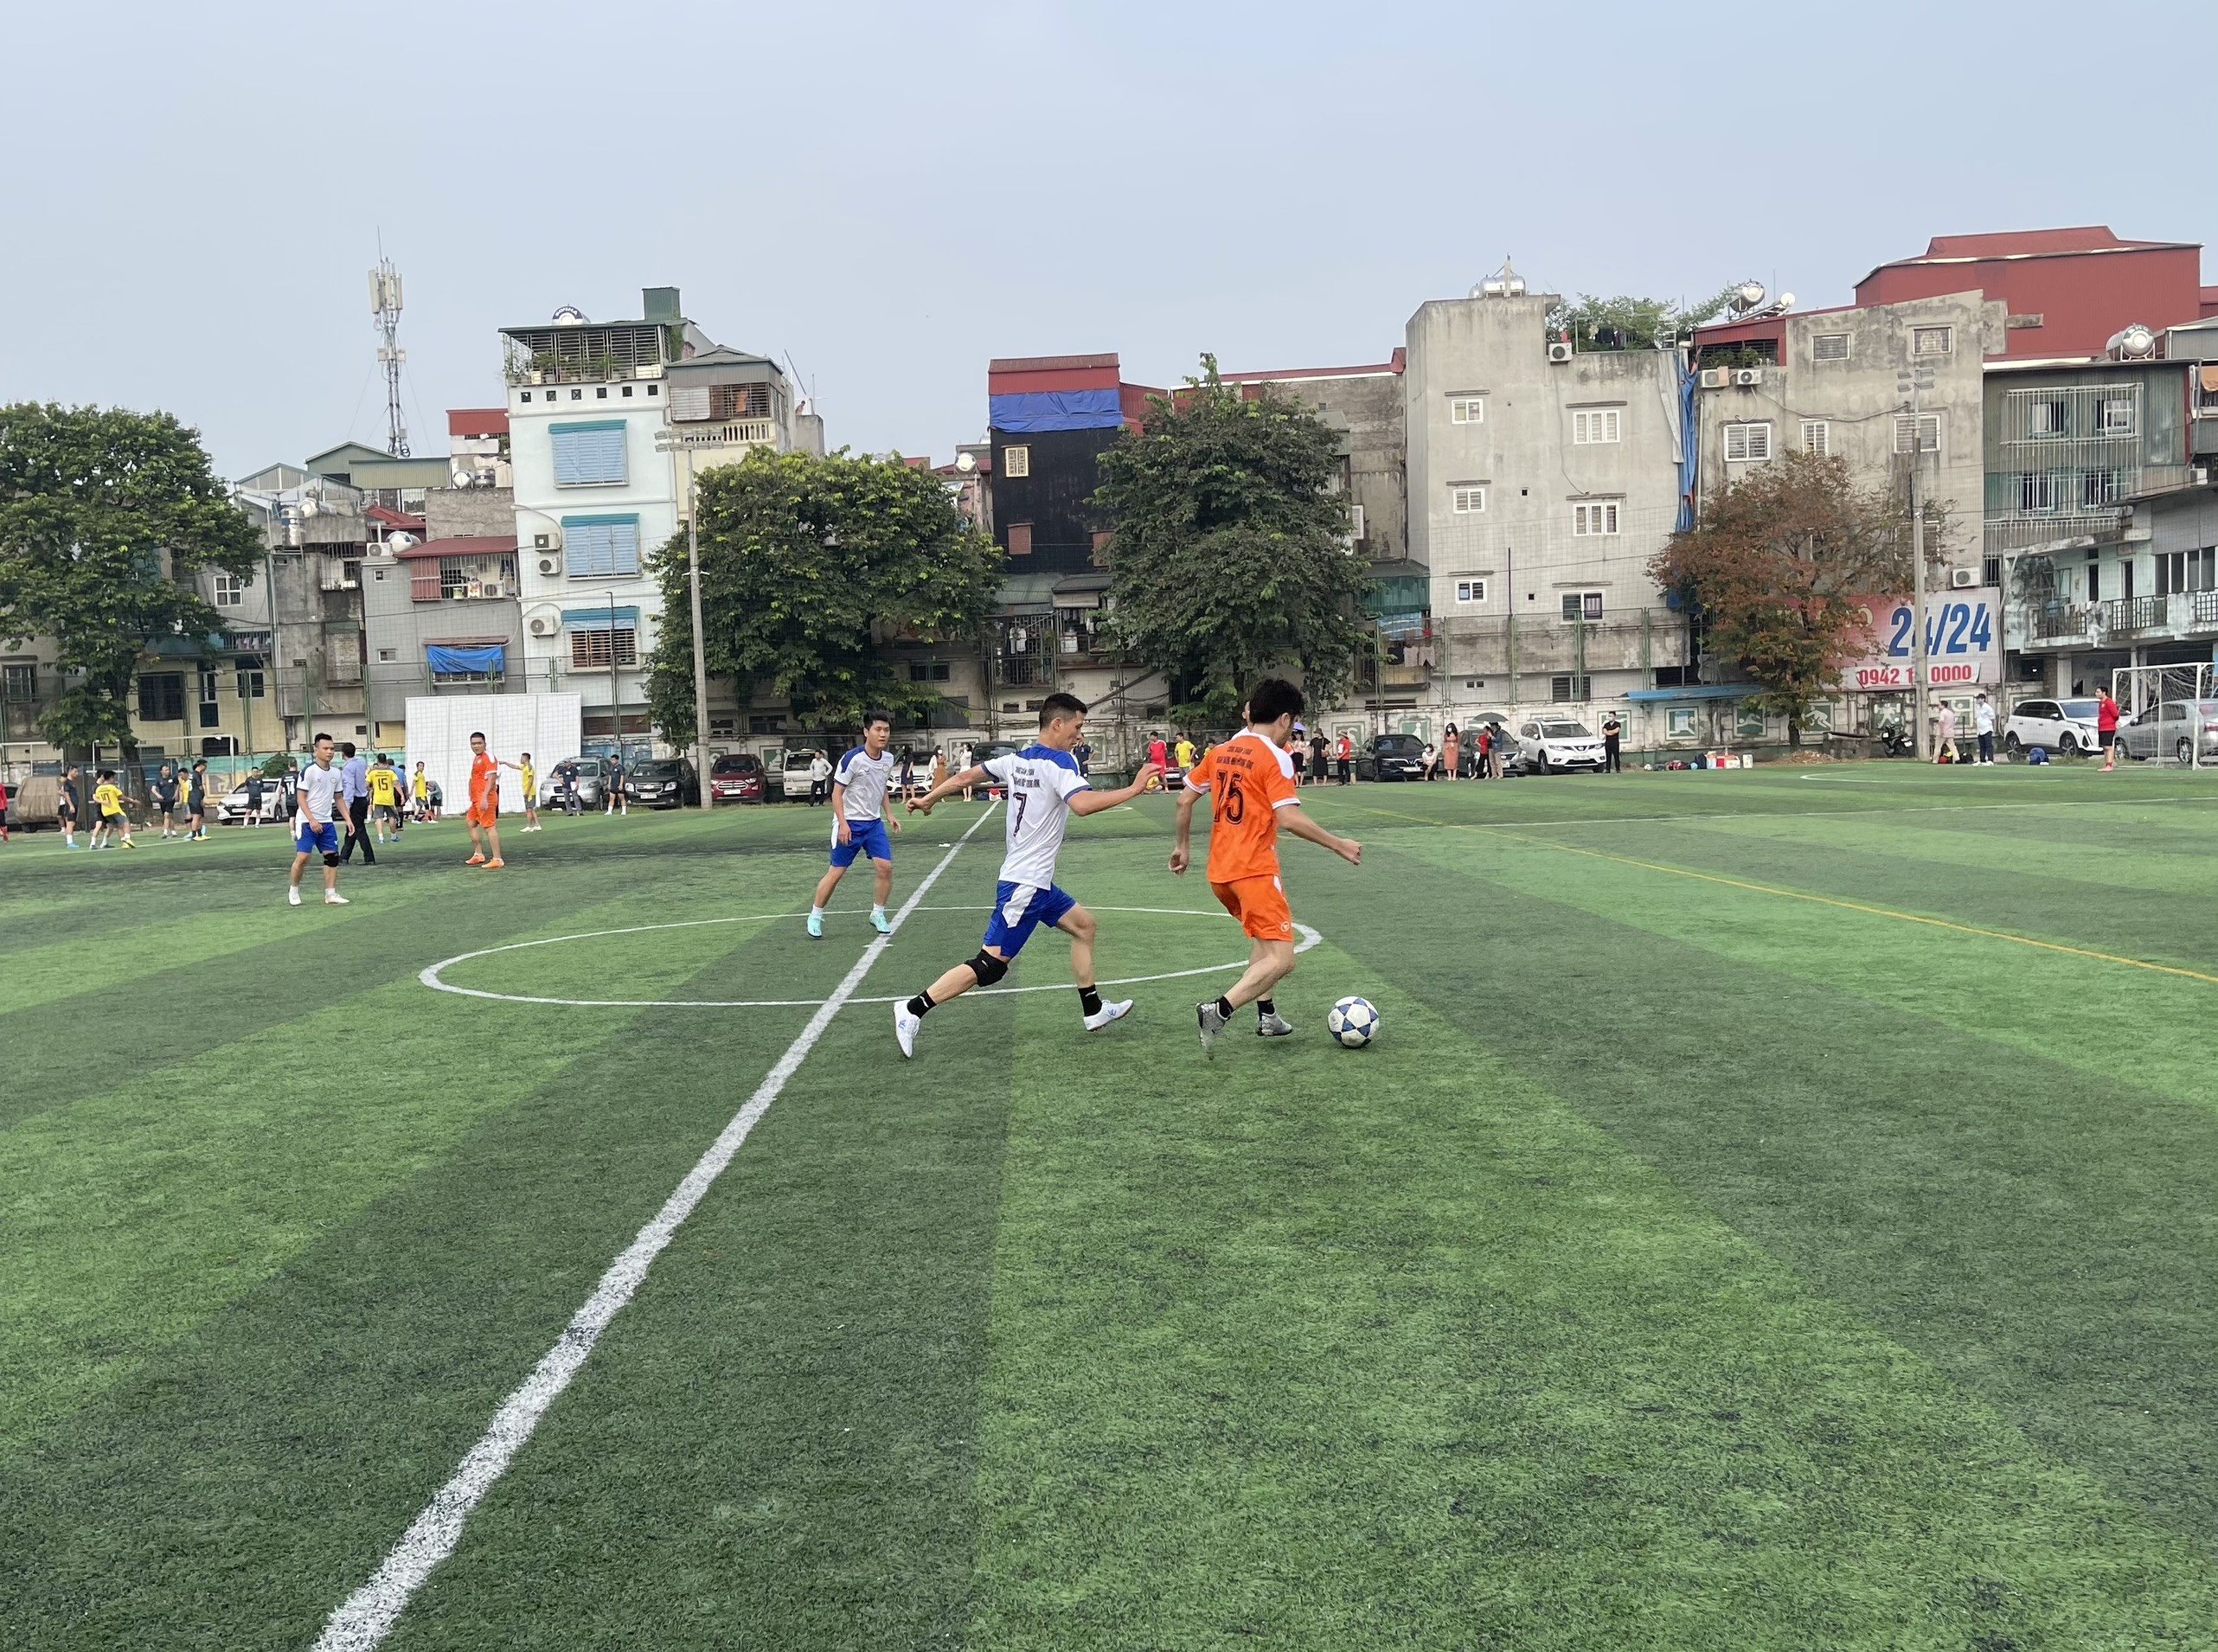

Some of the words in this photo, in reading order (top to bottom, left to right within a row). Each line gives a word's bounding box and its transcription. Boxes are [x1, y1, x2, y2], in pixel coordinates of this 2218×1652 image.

[1860, 668, 1900, 685] 0942
[1931, 664, 1972, 682] 0000
[378, 778, 388, 791] 15
[1013, 792, 1027, 837] 7
